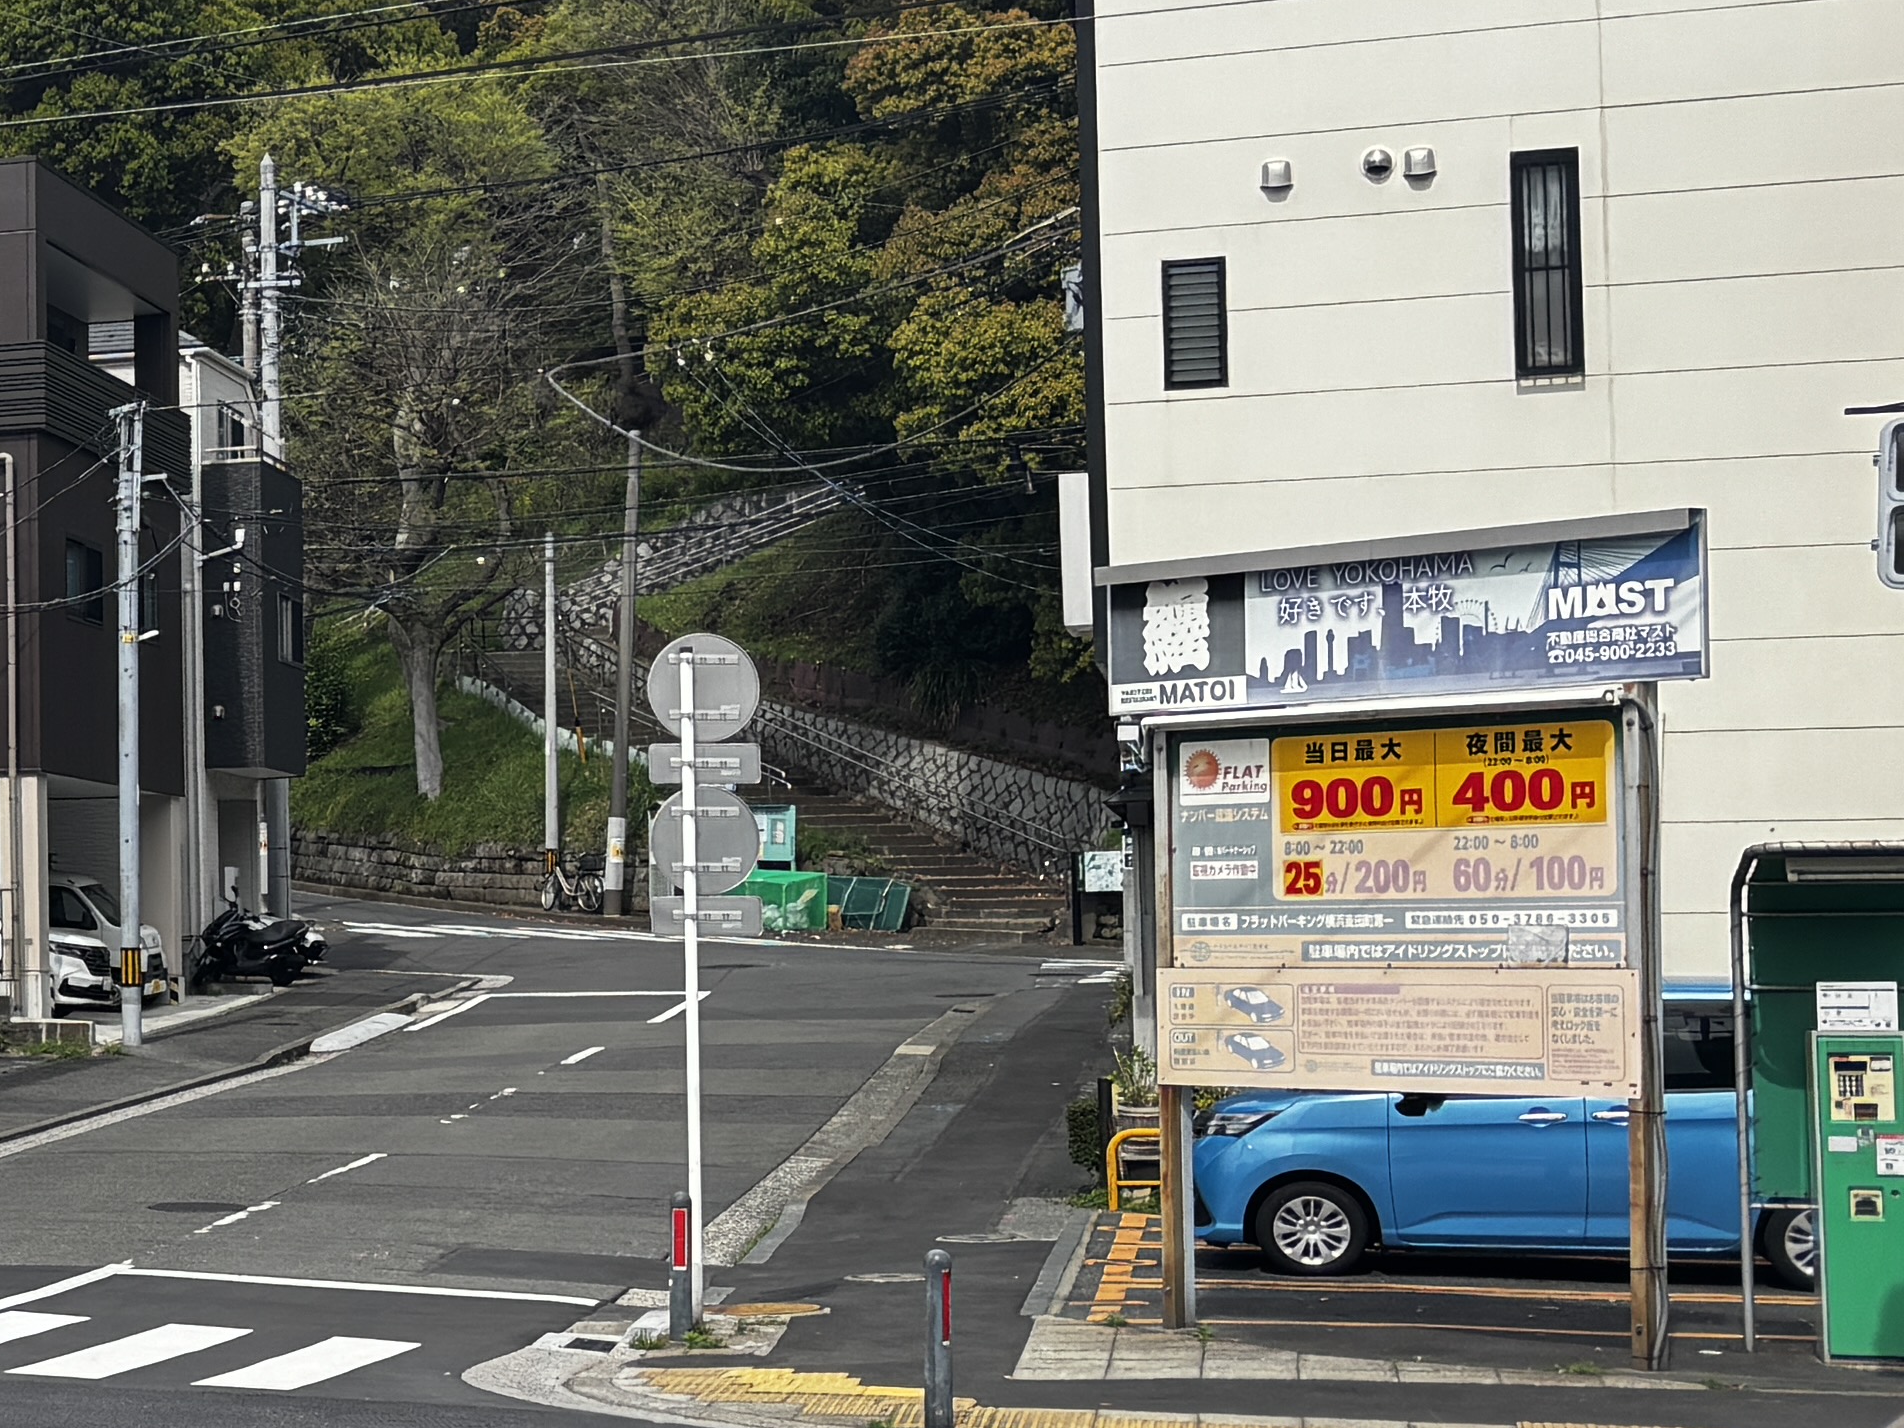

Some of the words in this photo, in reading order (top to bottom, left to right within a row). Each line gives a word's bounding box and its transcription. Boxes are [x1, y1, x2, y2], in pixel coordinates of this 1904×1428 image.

[1261, 567, 1319, 593] LOVE
[1332, 553, 1474, 586] YOKOHAMA
[1565, 641, 1677, 664] 045-900-2233
[1159, 679, 1235, 705] MATOI
[1304, 737, 1402, 765] 当日最大
[1465, 728, 1574, 757] 夜間最大
[1221, 780, 1268, 793] Parking
[1222, 765, 1264, 780] FLAT
[1291, 775, 1424, 820] 900円
[1452, 768, 1596, 813] 400円
